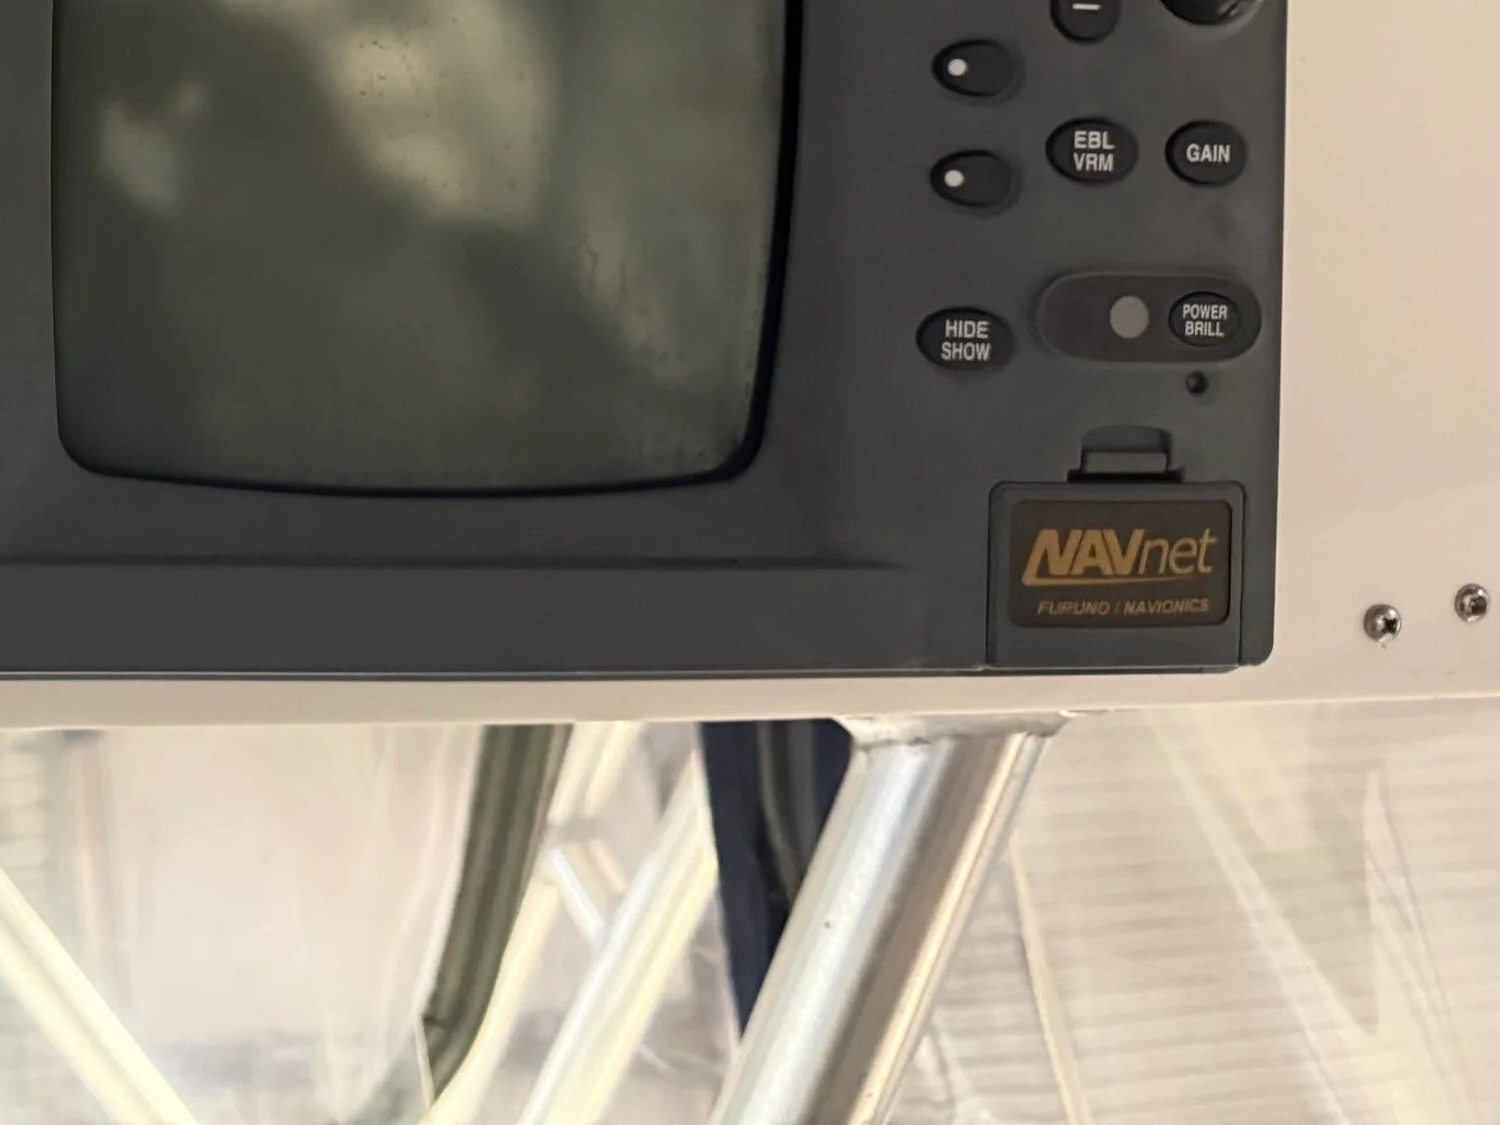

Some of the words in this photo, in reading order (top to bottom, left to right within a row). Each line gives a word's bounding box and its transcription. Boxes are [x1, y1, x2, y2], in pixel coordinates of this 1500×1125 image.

[1074, 130, 1115, 150] EBL
[1073, 151, 1114, 172] VRM
[1186, 142, 1230, 164] GAIN
[1182, 303, 1228, 320] POWER
[945, 320, 990, 339] HIDE
[1184, 320, 1224, 337] BRILL
[941, 341, 990, 362] SHOW
[1021, 527, 1218, 586] NAVnet
[1037, 601, 1111, 616] FURUNO
[1124, 598, 1210, 615] NAVIONICS
